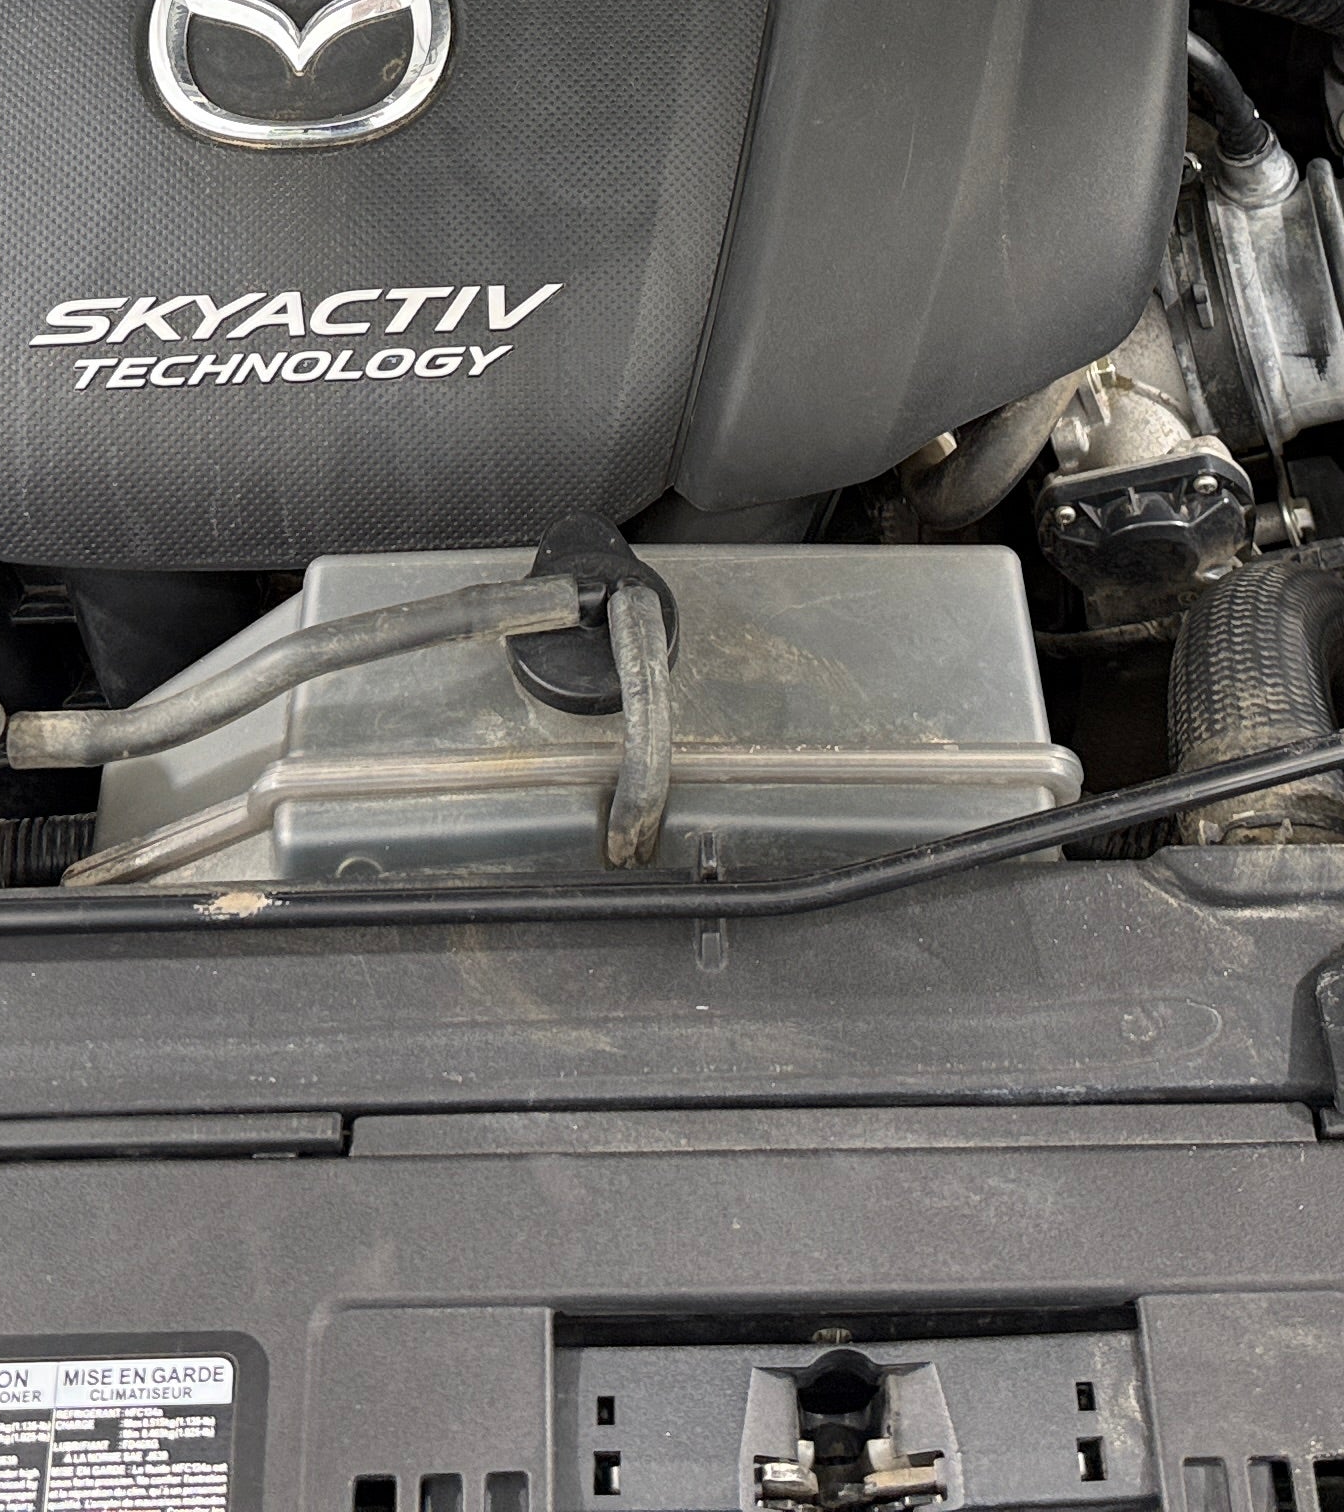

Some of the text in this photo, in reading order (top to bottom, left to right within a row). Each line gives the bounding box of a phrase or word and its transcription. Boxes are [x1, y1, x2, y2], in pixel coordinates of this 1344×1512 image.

[30, 284, 563, 346] SKYACTIV
[74, 345, 514, 390] TECHNOLOGY
[63, 1366, 225, 1386] MISE EN GARDE
[90, 1386, 193, 1402] CLIMATISEUR
